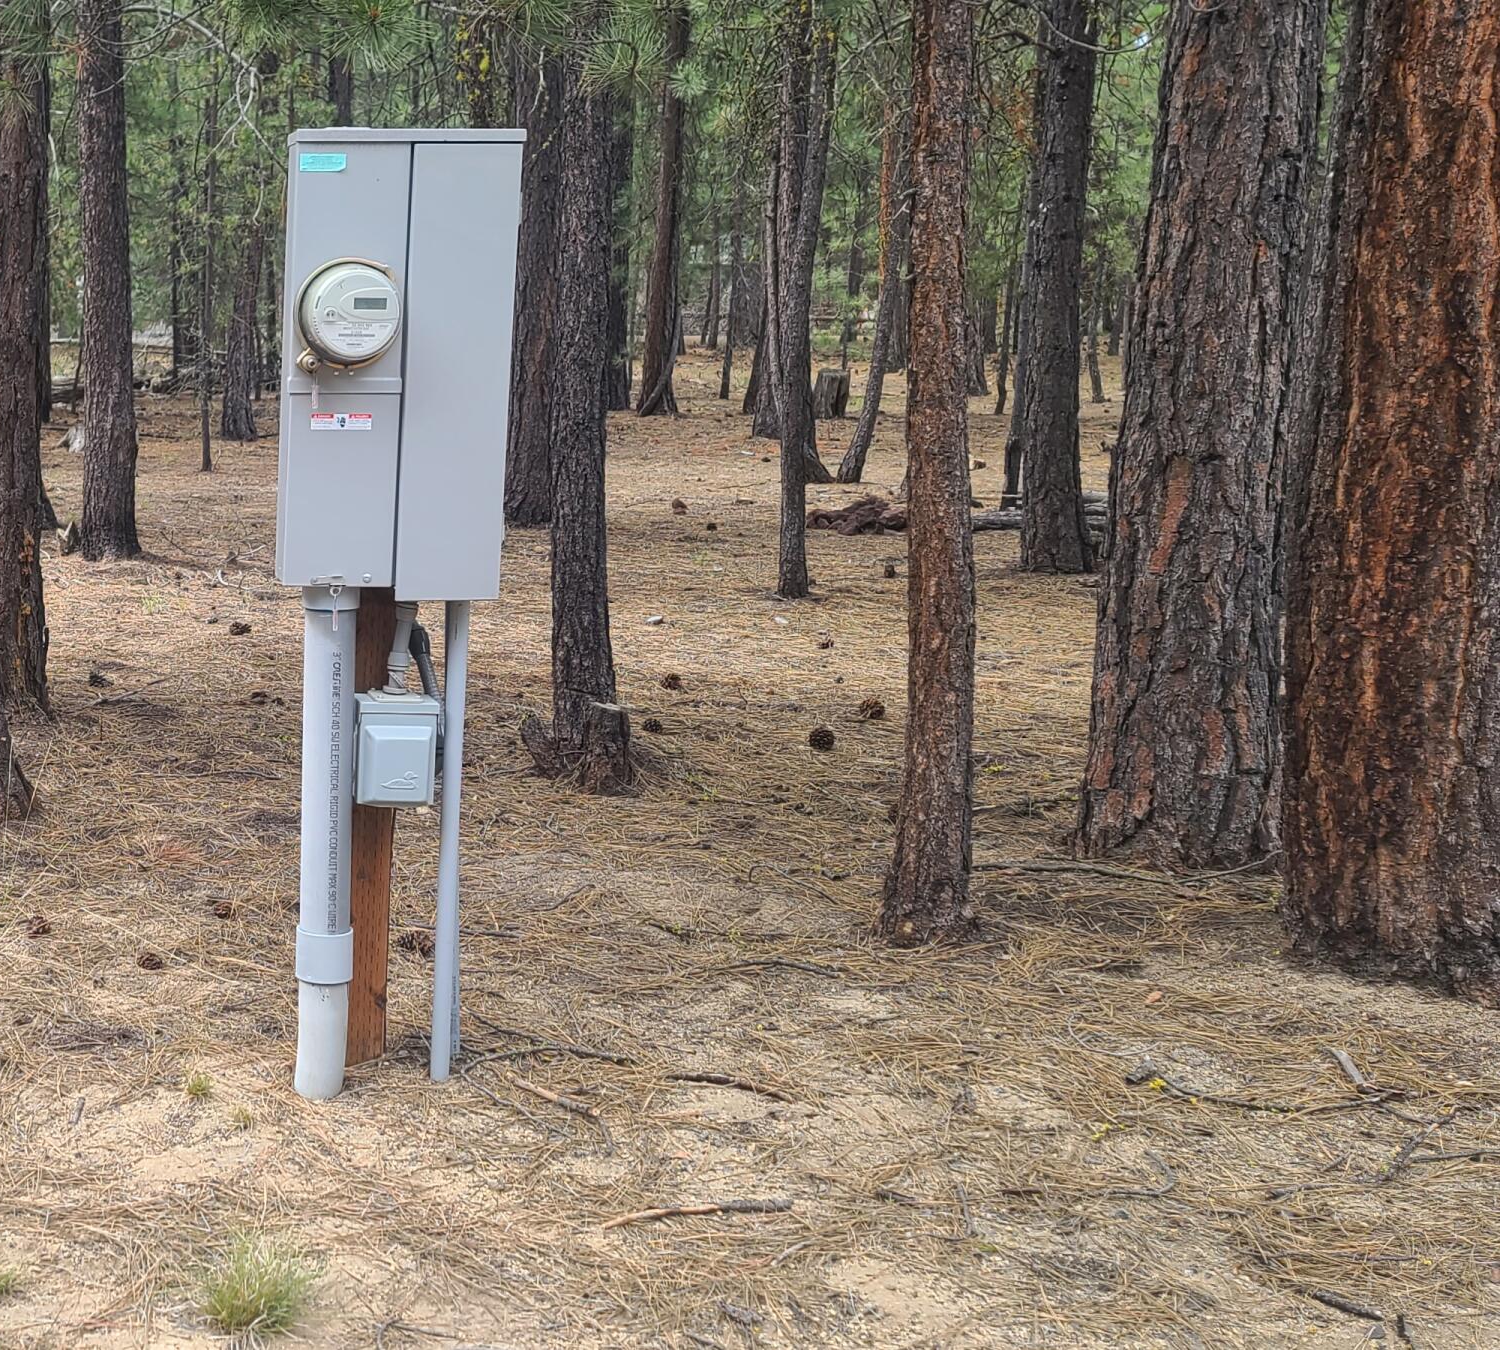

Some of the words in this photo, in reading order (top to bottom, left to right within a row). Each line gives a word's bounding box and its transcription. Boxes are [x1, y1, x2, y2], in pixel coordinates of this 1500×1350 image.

[331, 701, 341, 718] SCH
[331, 720, 340, 730] 40
[330, 744, 340, 793] ELECTRICAL
[329, 795, 339, 819] RIGID
[329, 820, 338, 835] PVC
[328, 837, 338, 872] CONDUIT
[328, 873, 337, 889] MAX
[327, 911, 337, 929] WIRE
